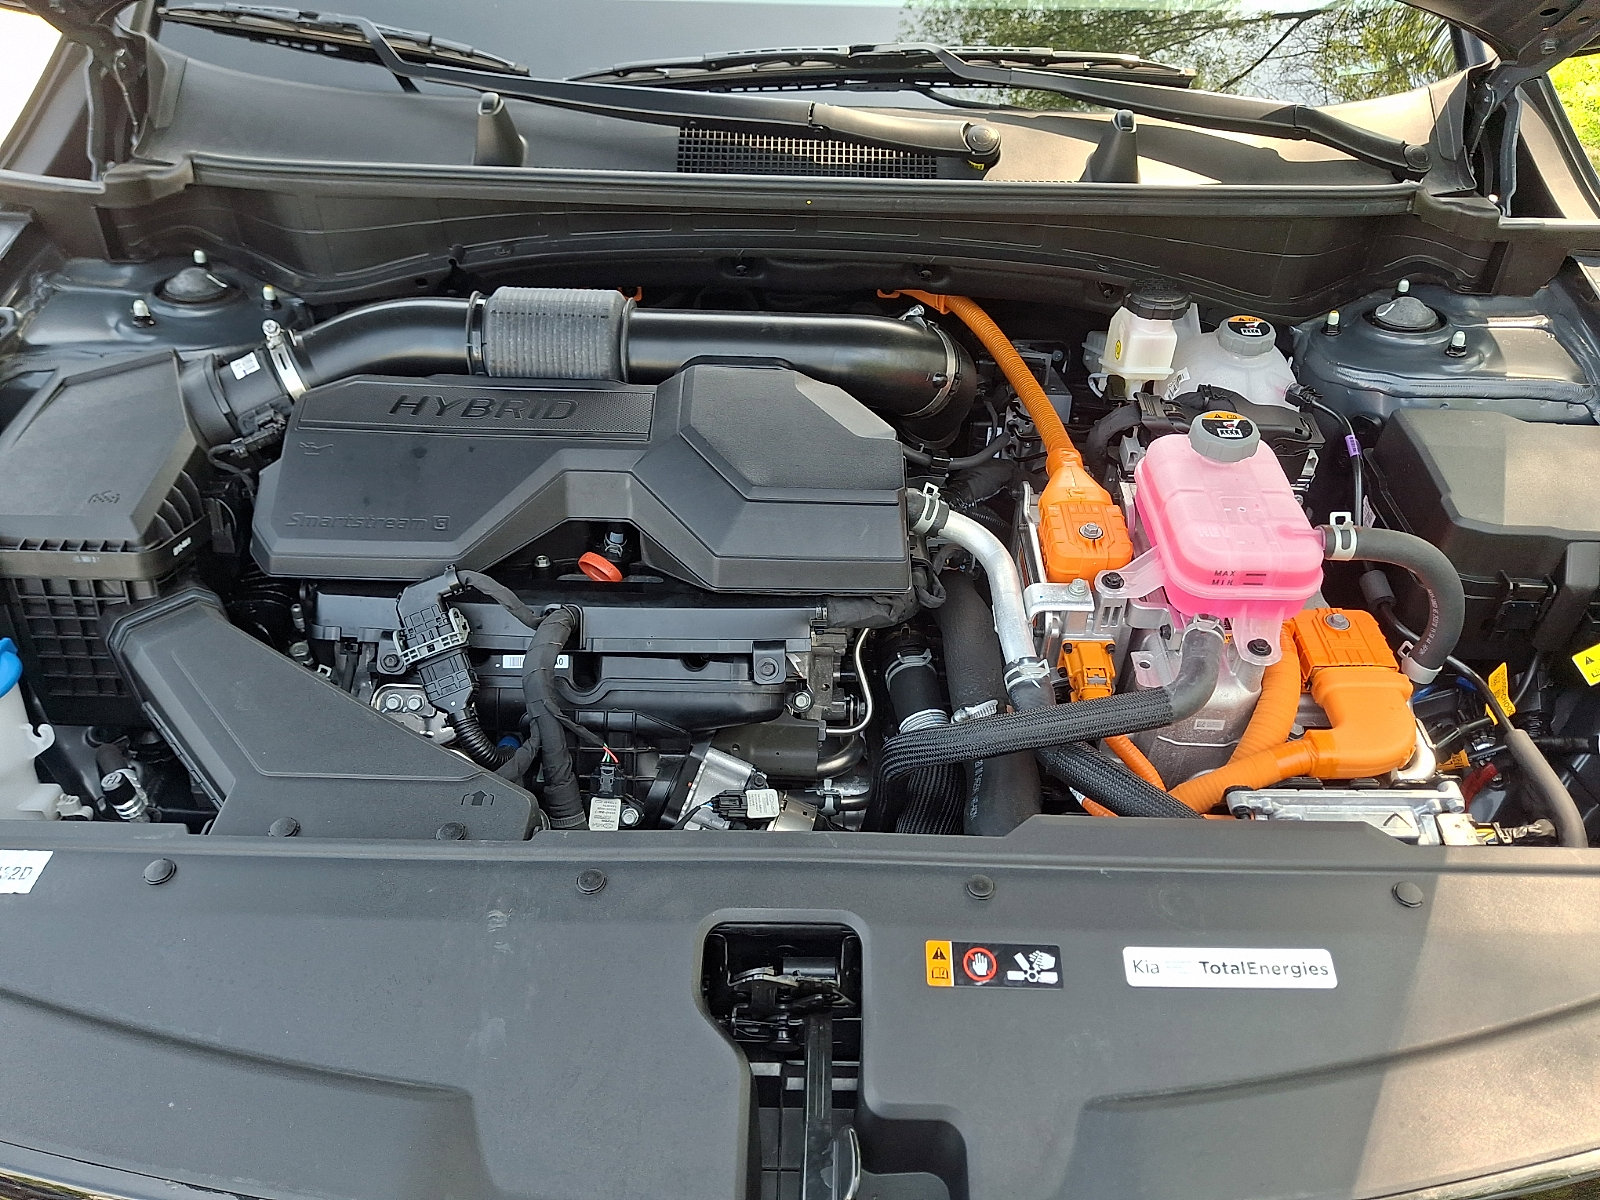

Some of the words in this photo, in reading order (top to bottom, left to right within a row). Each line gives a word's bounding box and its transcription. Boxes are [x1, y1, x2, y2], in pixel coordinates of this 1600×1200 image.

[388, 394, 580, 420] HYBRID
[285, 511, 428, 530] Smartstream
[1132, 959, 1160, 974] Kia
[1198, 961, 1329, 978] TotalEnergies
